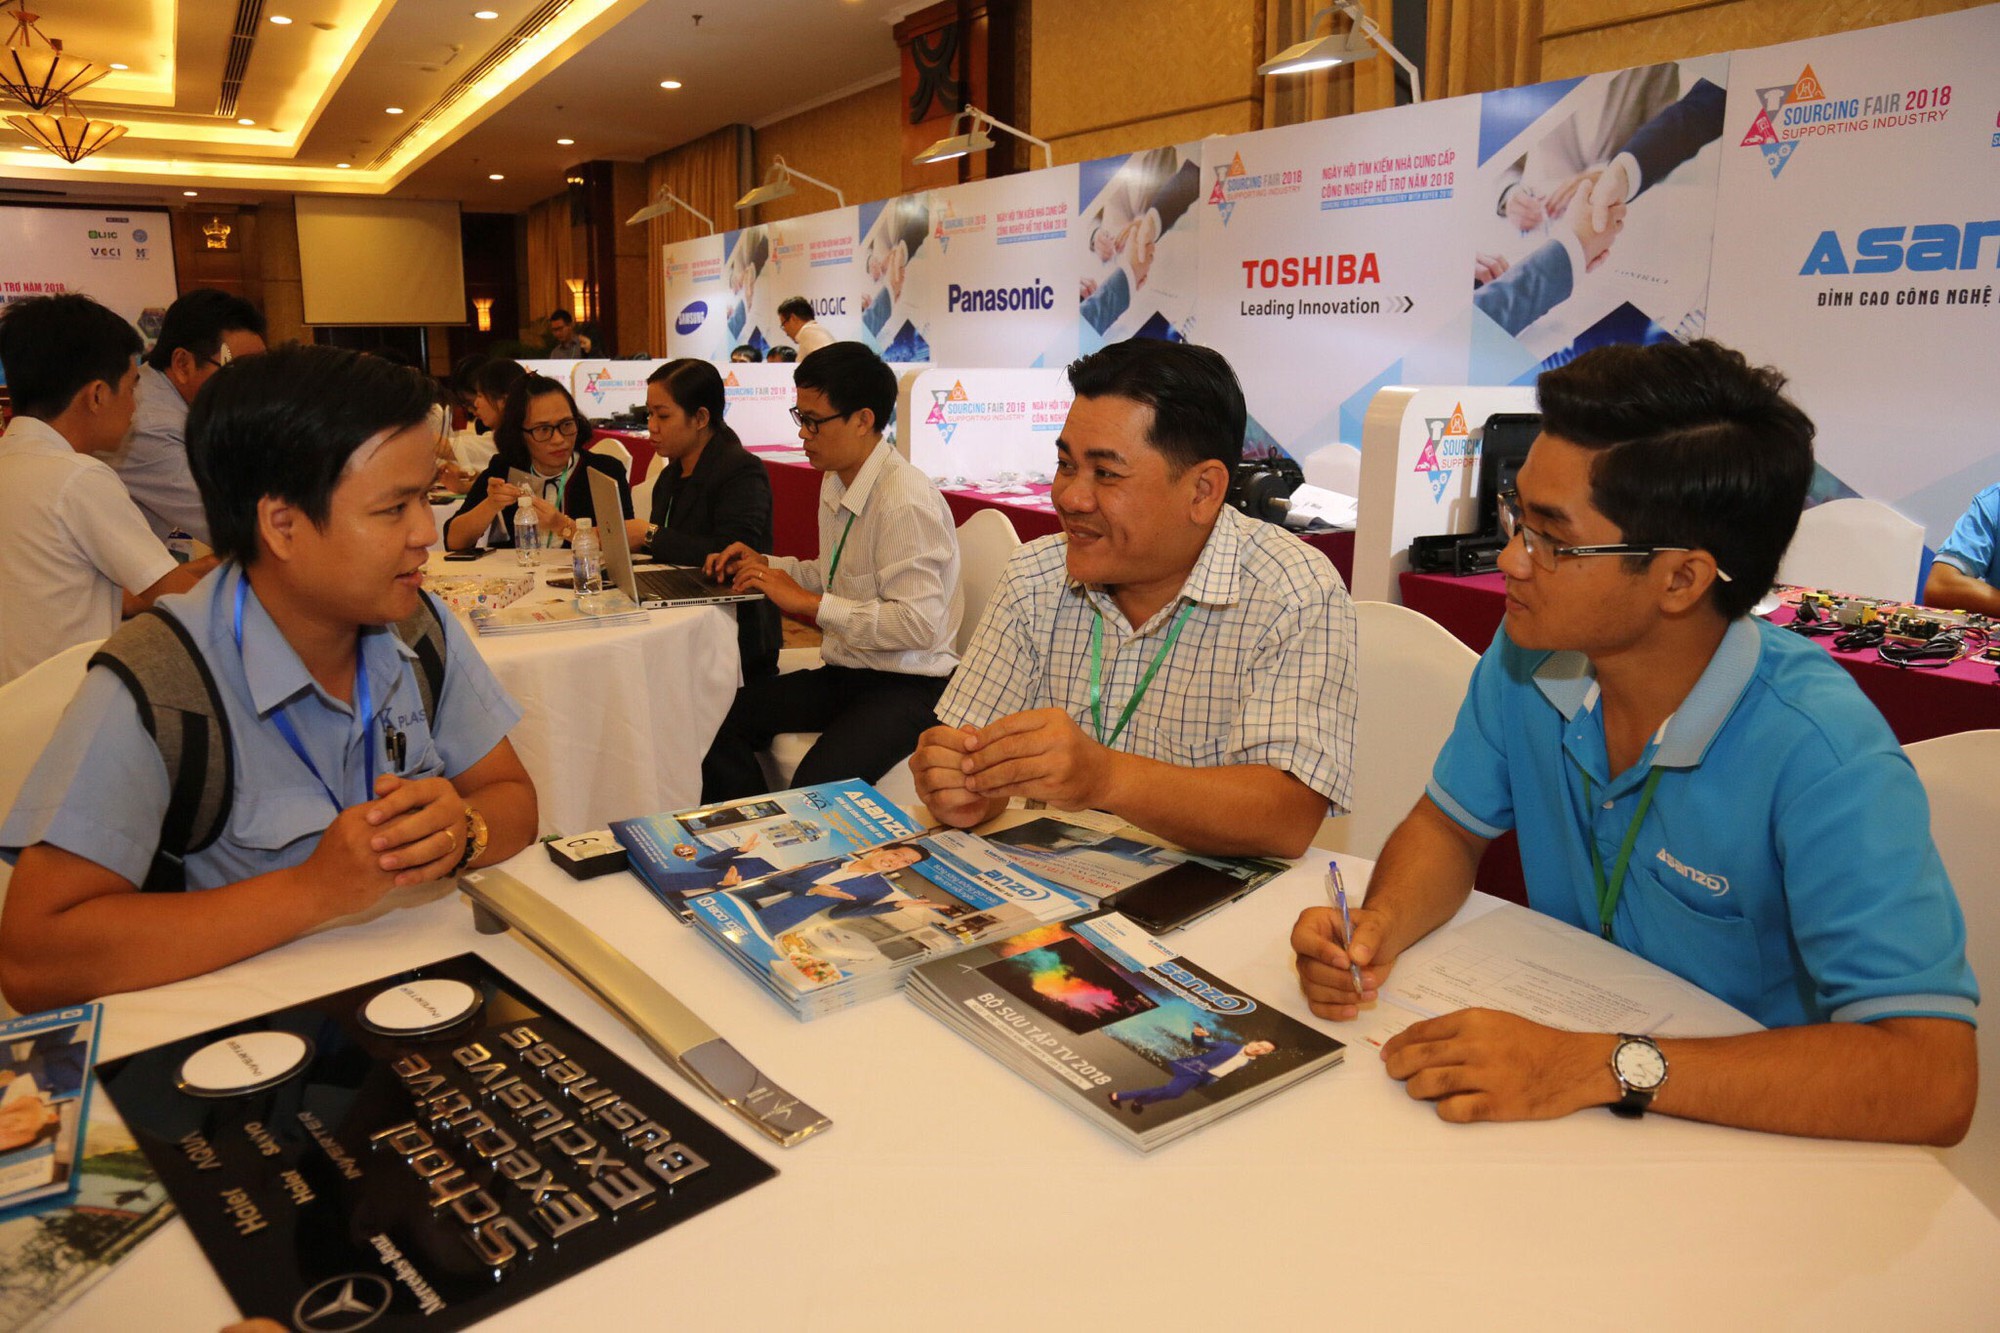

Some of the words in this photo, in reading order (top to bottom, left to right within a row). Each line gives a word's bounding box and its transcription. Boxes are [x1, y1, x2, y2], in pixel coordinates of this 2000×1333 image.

[1781, 118, 1869, 140] SUPPORTING
[1872, 109, 1949, 129] INDUSTRY
[1783, 98, 1859, 126] SOURCING
[1863, 93, 1901, 116] FAIR
[1905, 85, 1952, 110] 2018
[1281, 169, 1302, 185] 2018
[1430, 172, 1454, 187] 2018
[90, 247, 121, 257] VCCI
[1242, 252, 1380, 289] TOSHIBA
[44, 282, 65, 293] 2018
[948, 277, 1054, 313] Panasonic
[1859, 290, 1890, 306] CAO
[1896, 286, 1940, 306] CÔNG
[1946, 284, 1993, 308] NGHỆ
[1240, 299, 1294, 320] Leading
[1298, 296, 1380, 316] Innovation
[947, 402, 985, 414] SOURCING
[987, 401, 1005, 413] FAIR
[1005, 401, 1026, 413] 2018
[842, 790, 916, 839] Asanzo
[983, 868, 1038, 898] anzo
[1656, 847, 1721, 891] Asanzo
[1154, 960, 1240, 1010] sanzo
[977, 991, 1006, 1009] BỘ
[995, 1005, 1031, 1029] SƯU
[1025, 1024, 1058, 1048] TẬP
[1052, 1045, 1079, 1062] TV
[1070, 1060, 1113, 1087] 2018
[499, 1026, 711, 1185] Business
[297, 1110, 364, 1180] INVERTER
[452, 1042, 657, 1211] Exclusive
[391, 1053, 600, 1240] Executive
[280, 1169, 316, 1205] Haier
[368, 1120, 539, 1266] School
[220, 1186, 270, 1236] Haier
[369, 1232, 447, 1317] Mercedes-Benz
